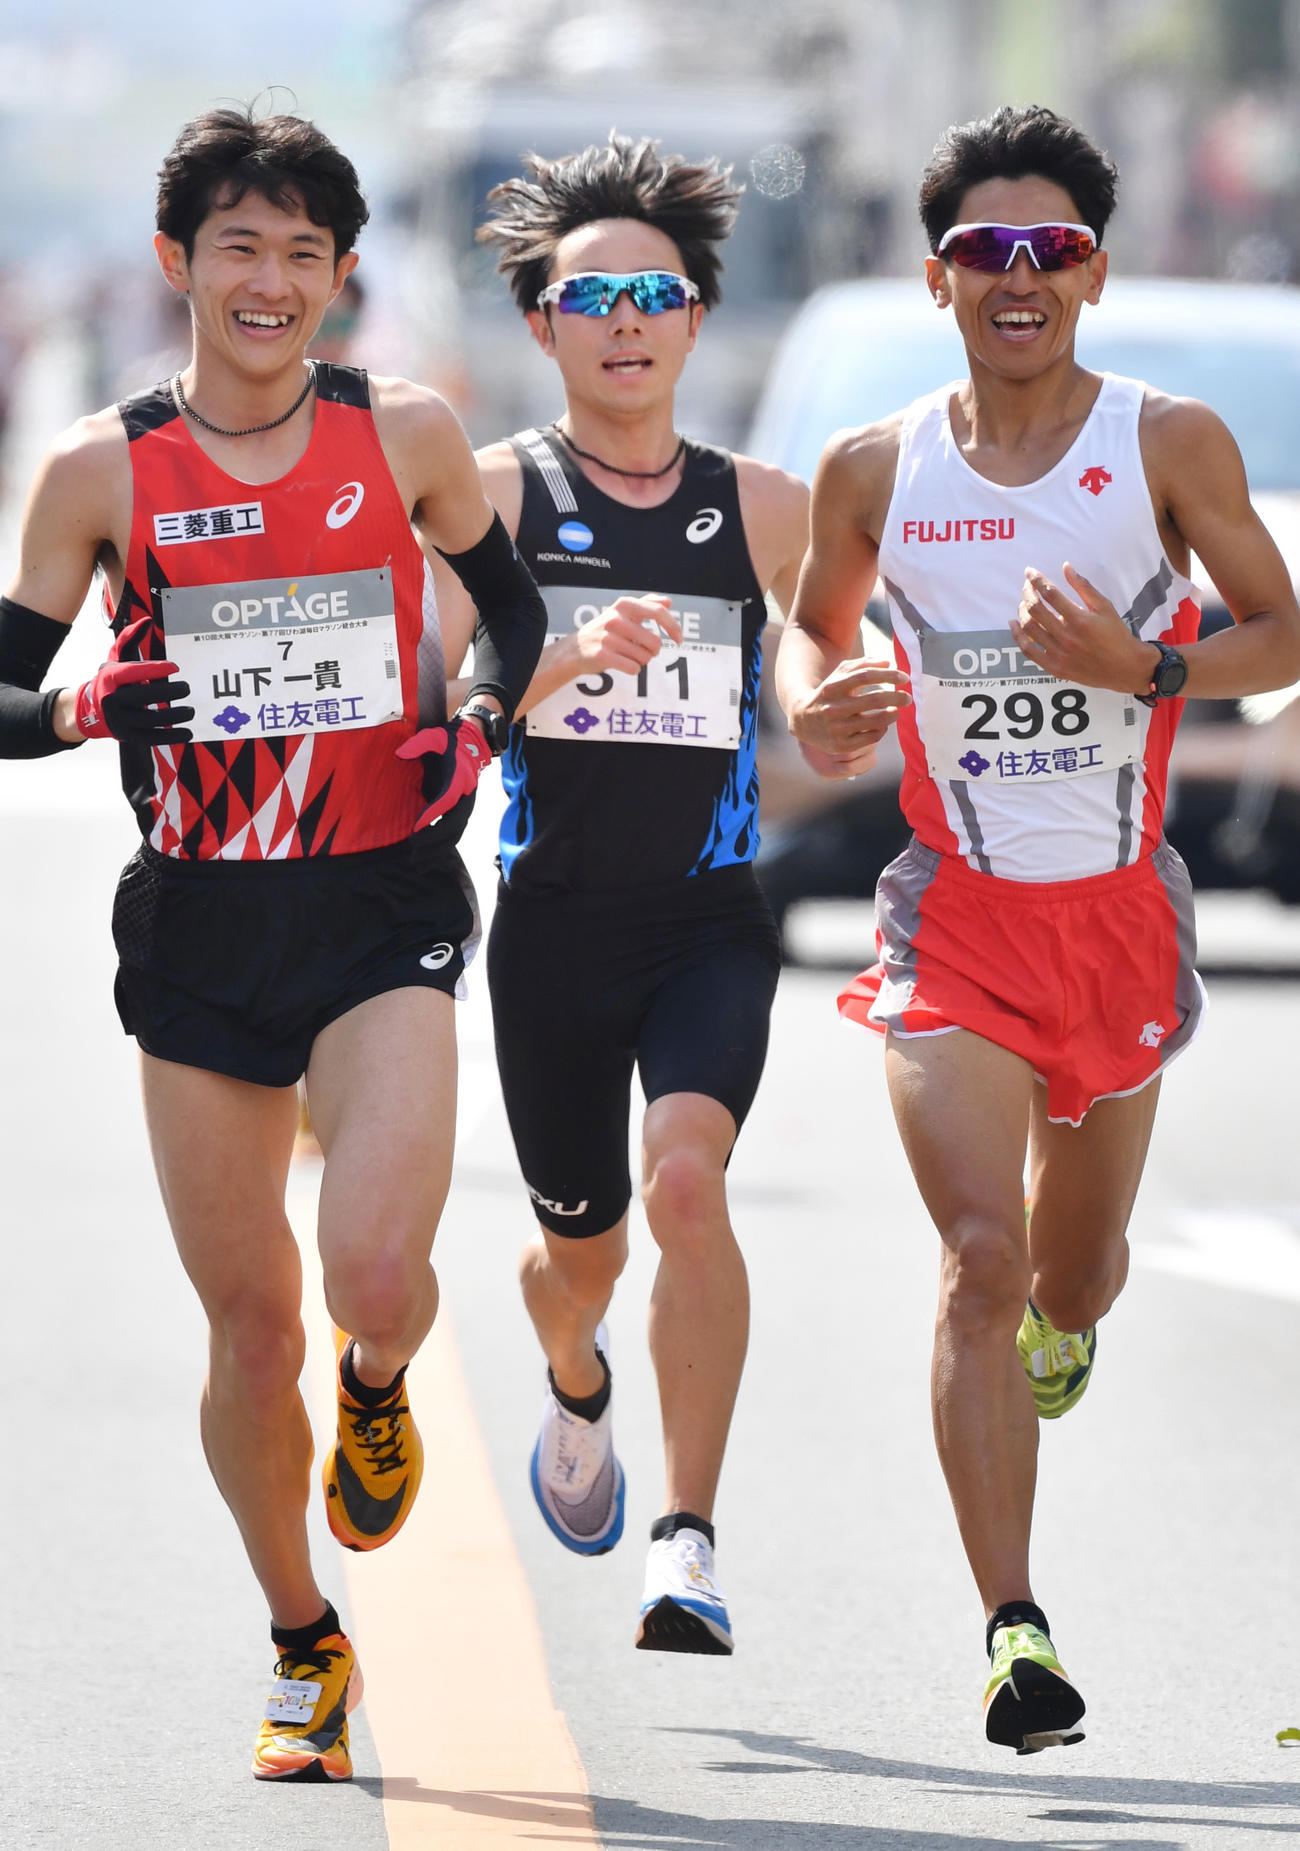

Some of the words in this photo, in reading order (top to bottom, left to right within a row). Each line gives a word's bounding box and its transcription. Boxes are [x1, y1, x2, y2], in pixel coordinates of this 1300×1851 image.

[157, 506, 262, 542] 三菱重工
[902, 517, 1015, 544] FUJITSU
[537, 552, 571, 563] KONICA
[573, 555, 611, 569] MINOLTA
[211, 583, 349, 627] OPTAGE
[277, 641, 293, 661] 7
[953, 646, 1045, 676] OPT
[212, 667, 272, 699] 山下
[284, 660, 342, 691] 一貴
[257, 696, 366, 731] 住友電工
[606, 707, 708, 739] 住友電工
[961, 688, 1090, 741] 298
[995, 743, 1104, 778] 住友電工
